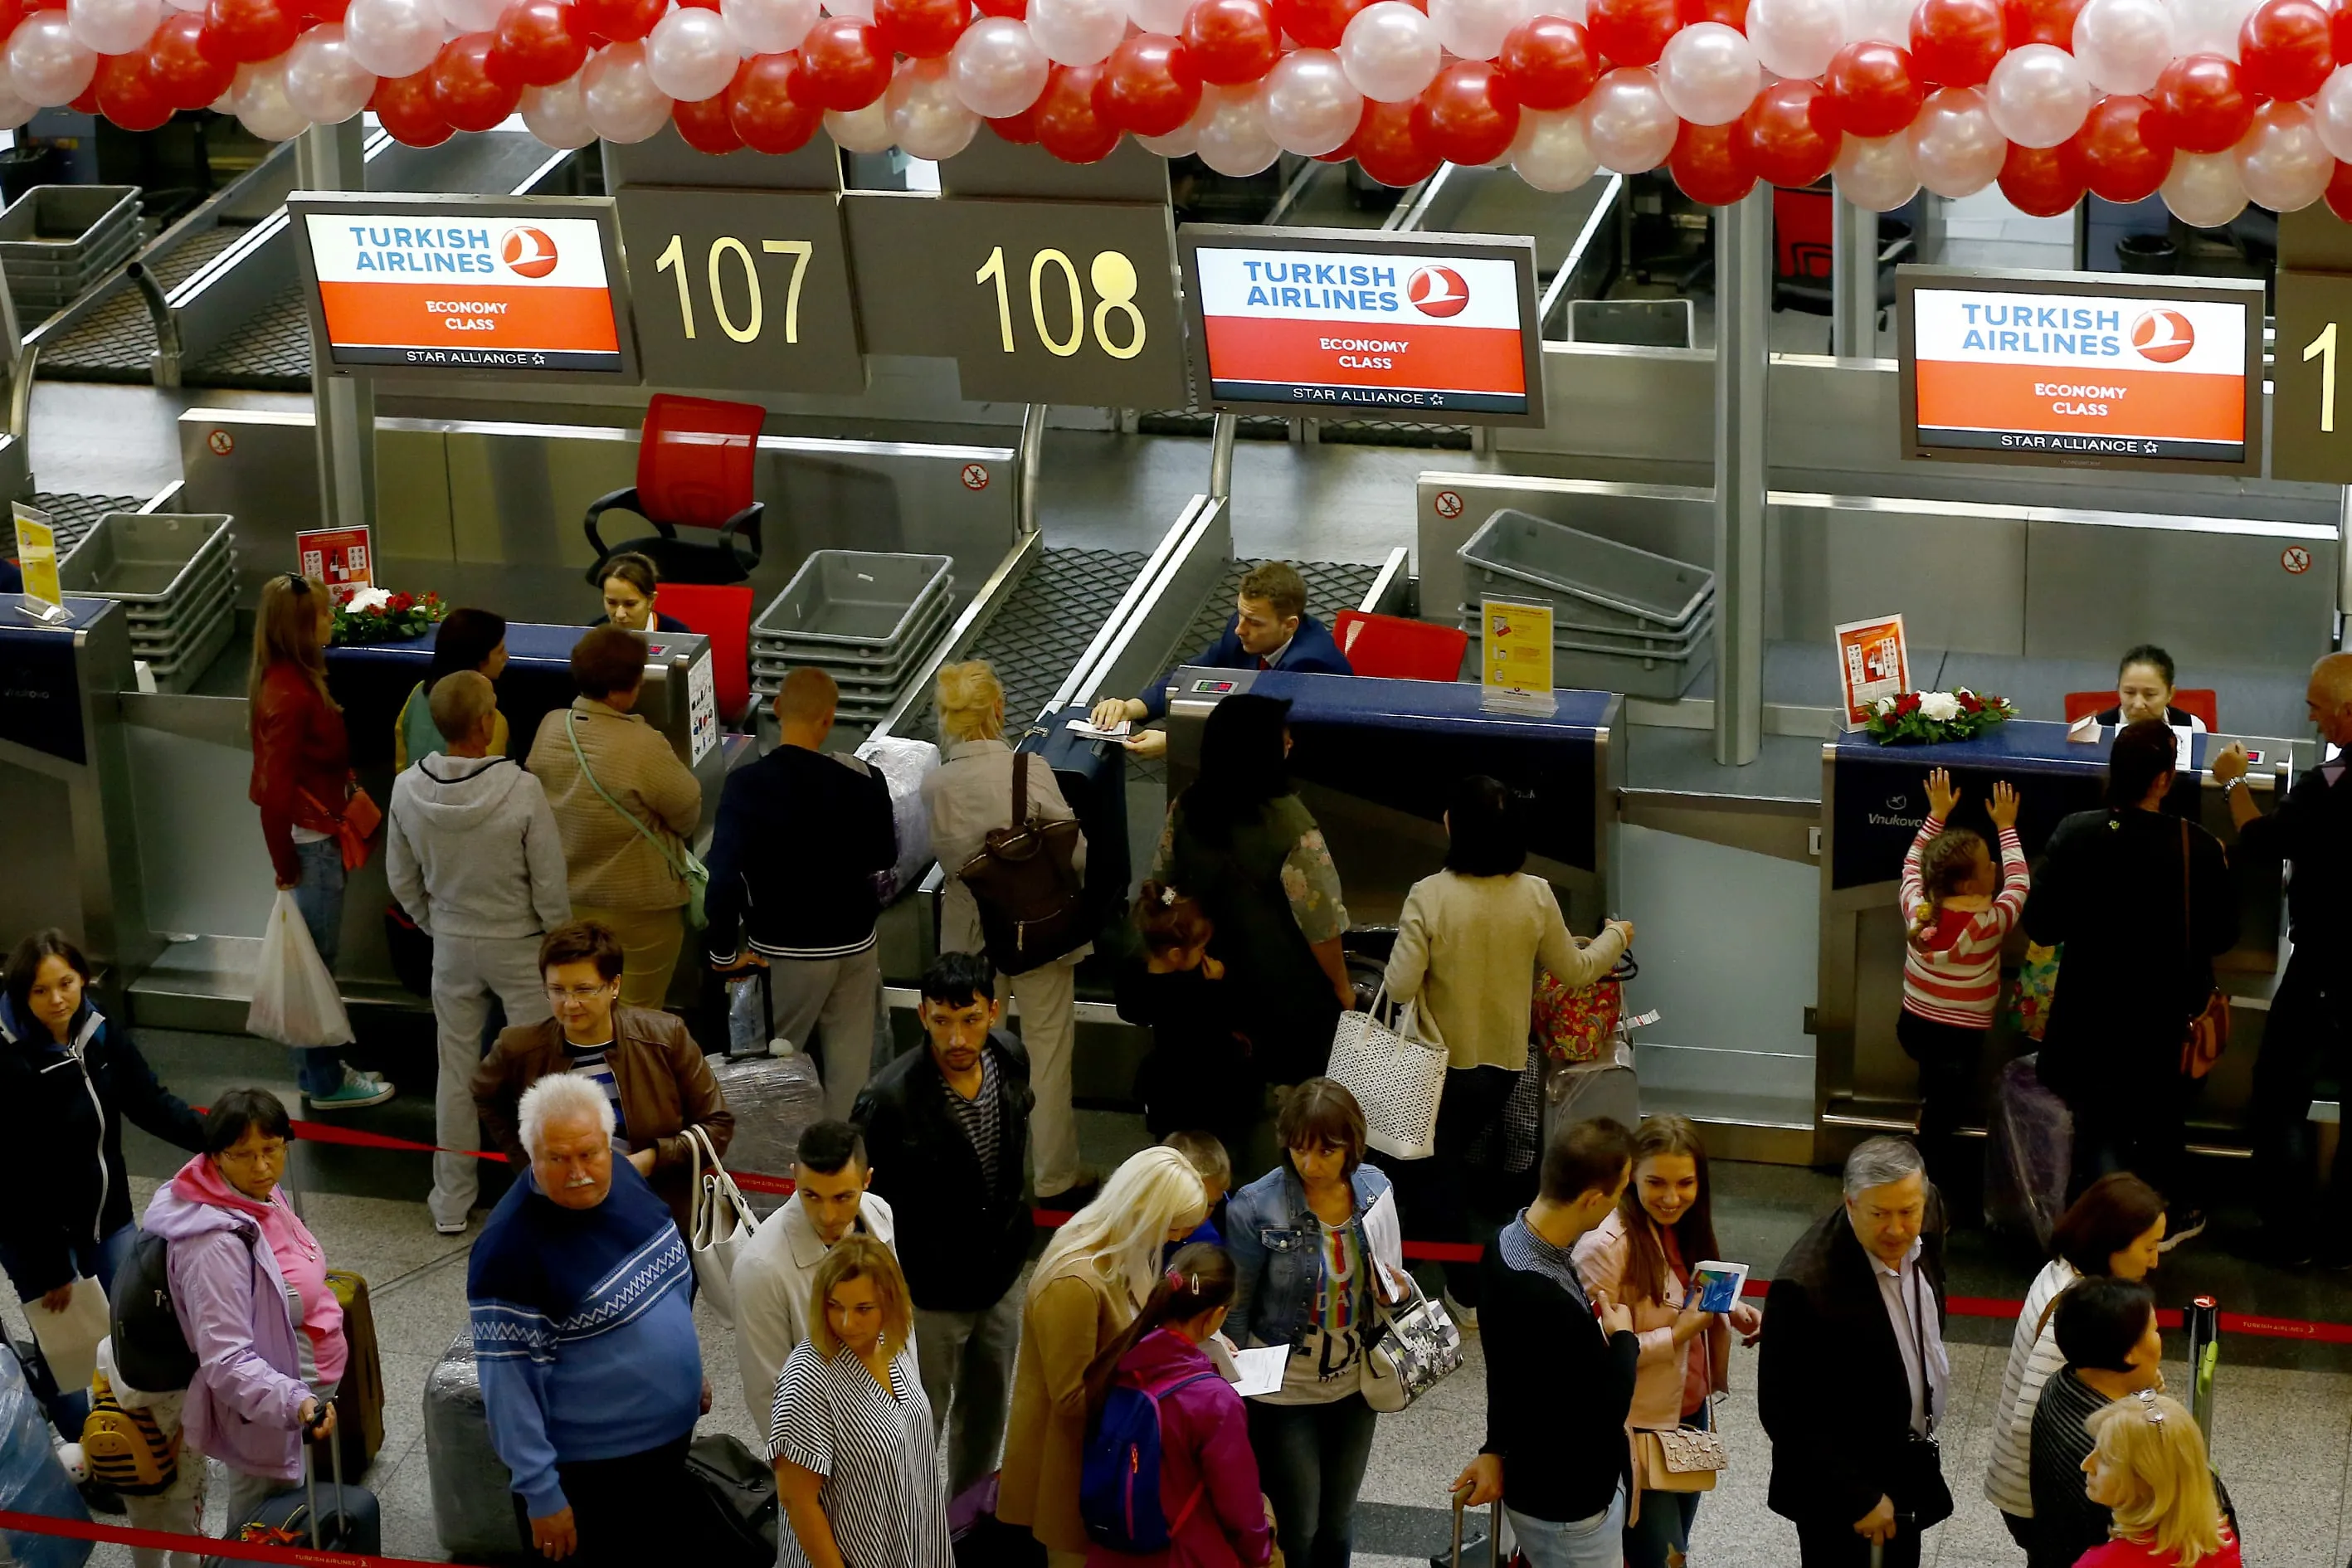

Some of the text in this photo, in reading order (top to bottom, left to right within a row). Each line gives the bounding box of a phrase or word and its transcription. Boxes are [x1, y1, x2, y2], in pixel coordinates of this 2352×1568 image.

[349, 226, 490, 249] TURKISH
[356, 251, 494, 273] AIRLINES
[1243, 261, 1396, 287] TURKISH
[655, 234, 814, 343] 107
[425, 300, 508, 314] ECONOMY
[976, 246, 1147, 359] 108
[1247, 285, 1399, 312] AIRLINES
[445, 318, 494, 331] CLASS
[1961, 303, 2120, 331] TURKISH
[1319, 337, 1409, 353] ECONOMY
[1962, 329, 2121, 357] AIRLINES
[406, 350, 528, 365] STAR ALLIANCE
[1338, 355, 1392, 370] CLASS
[1293, 387, 1424, 405] STAR ALLIANCE
[2033, 382, 2127, 399] ECONOMY
[2053, 402, 2108, 416] CLASS
[2000, 434, 2138, 453] STAR ALLIANCE
[1868, 813, 1923, 827] Vnukovo
[2242, 1321, 2272, 1329] TURKISH
[295, 1554, 356, 1566] TURKISH AIRLINES
